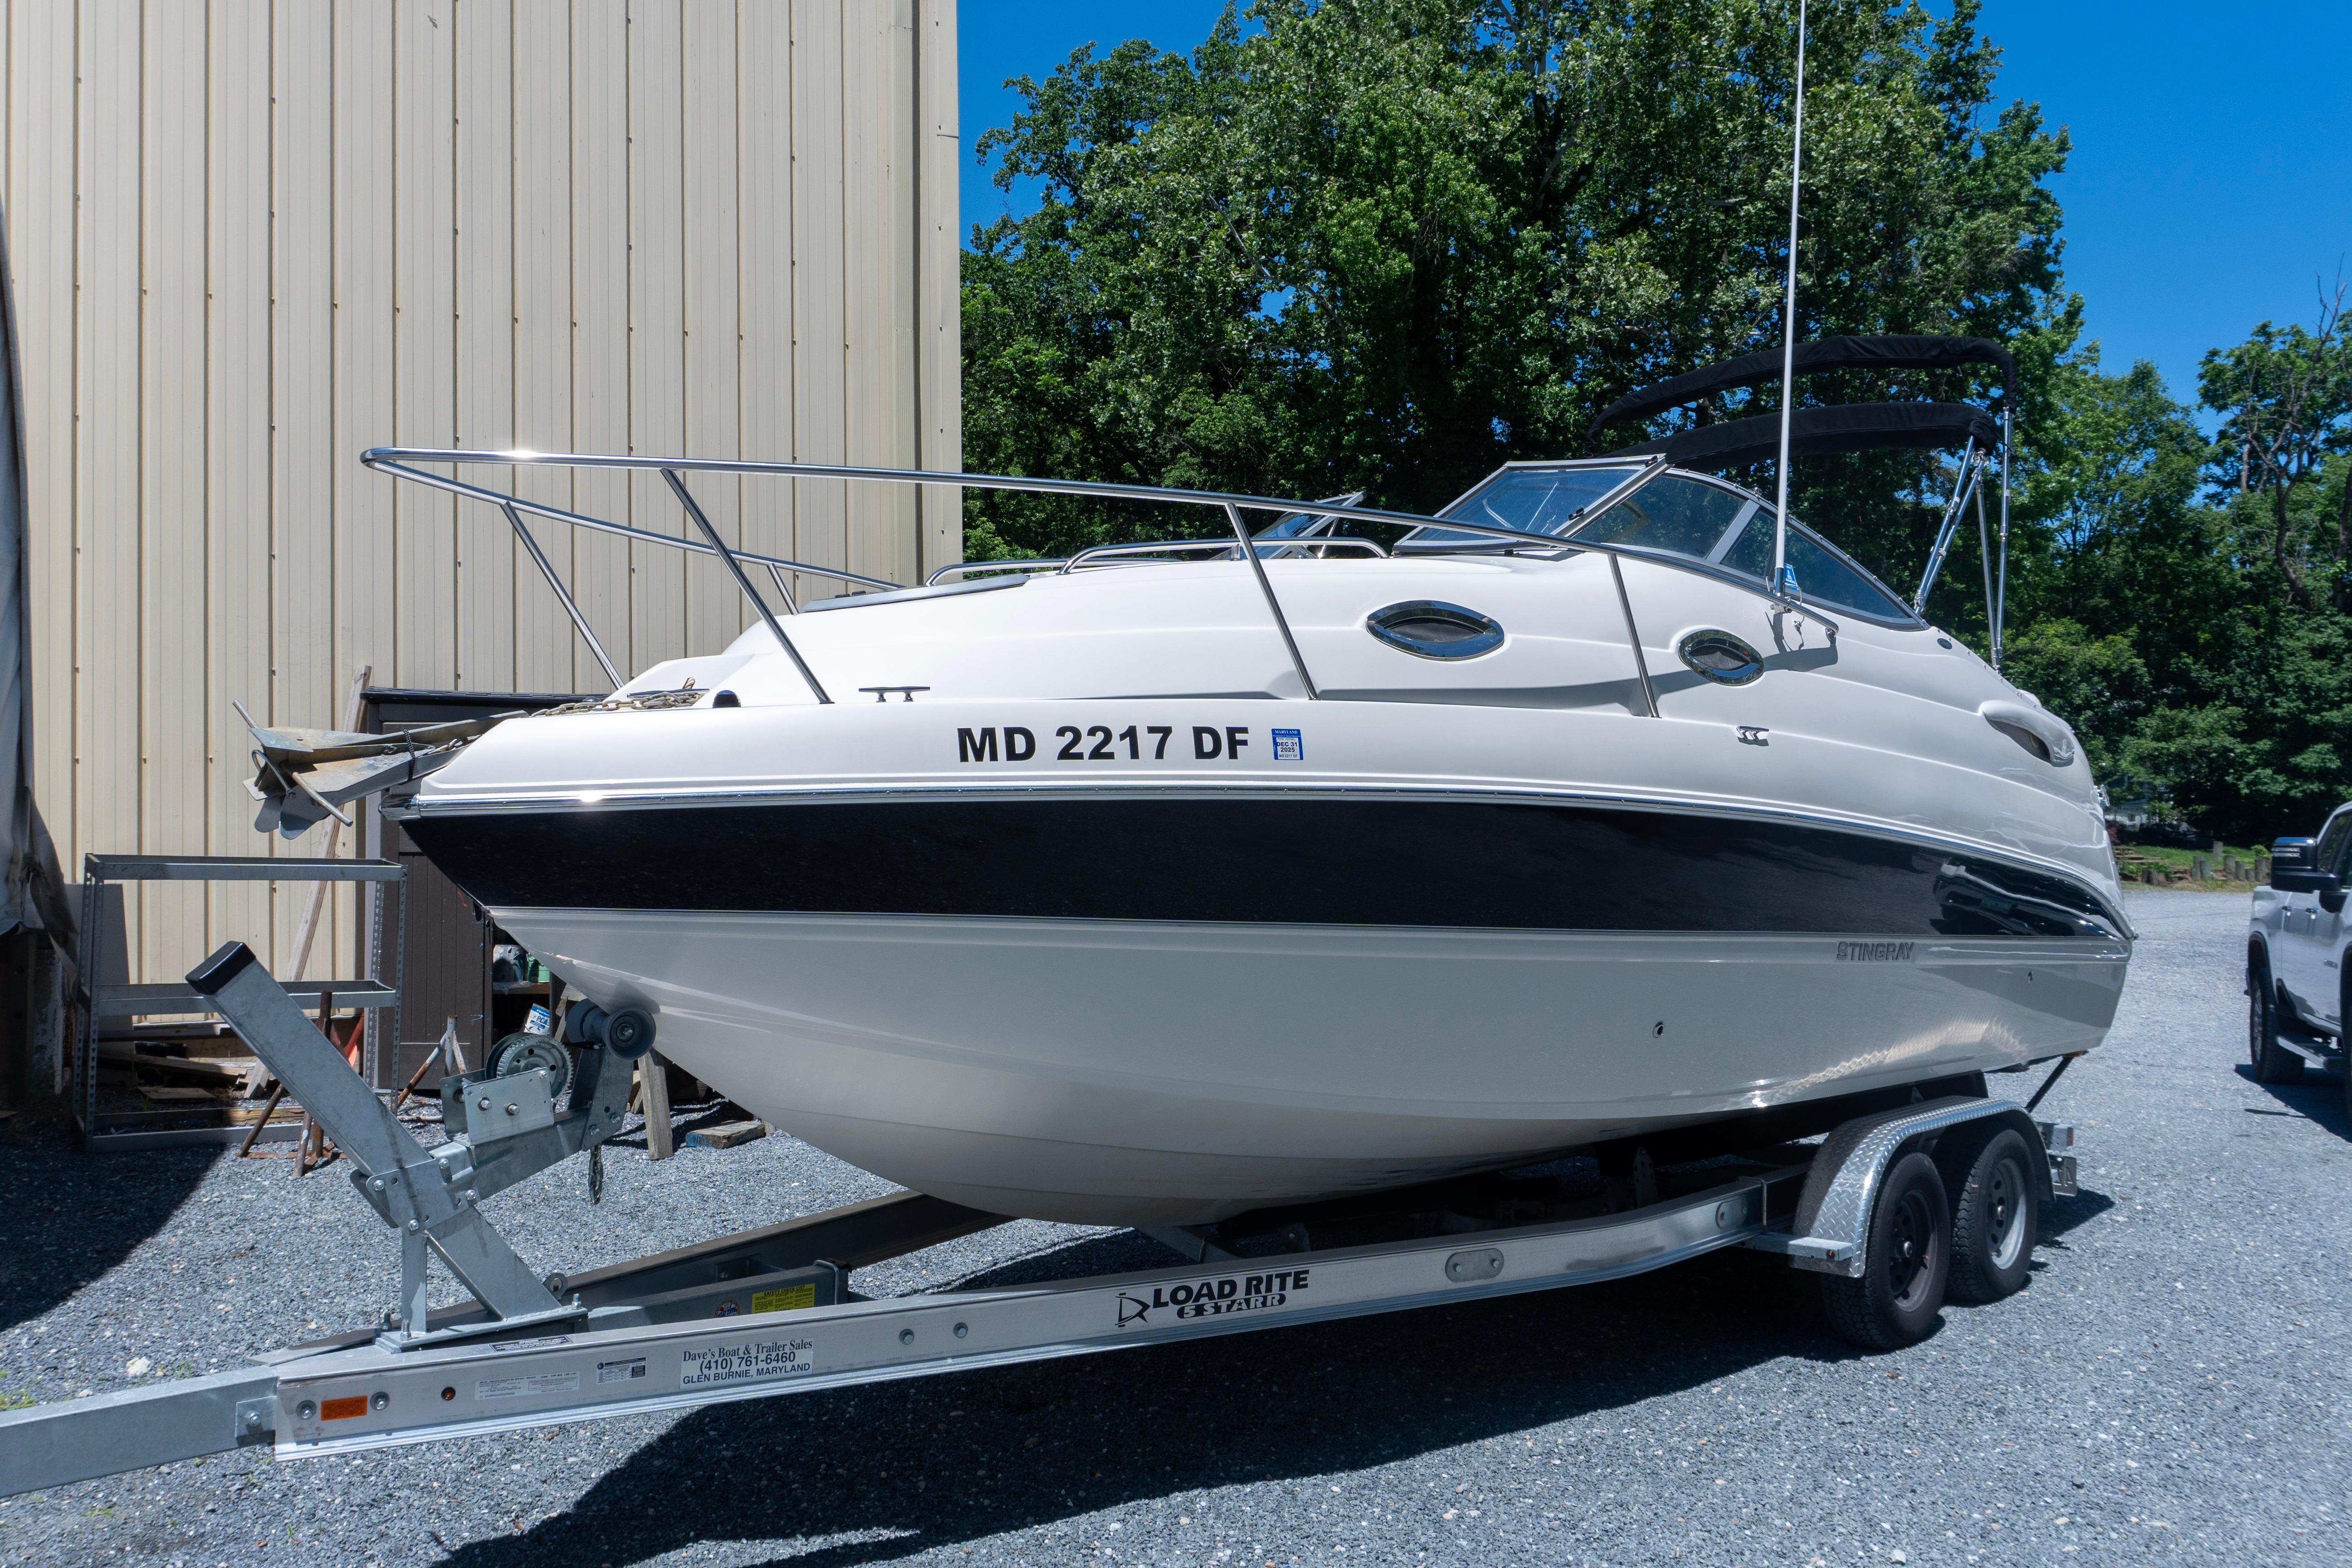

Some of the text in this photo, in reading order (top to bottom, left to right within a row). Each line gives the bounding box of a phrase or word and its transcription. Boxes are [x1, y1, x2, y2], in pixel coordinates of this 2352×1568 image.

[957, 725, 1249, 762] MD 2217 DF
[1837, 941, 1914, 961] STINGRAY
[536, 1016, 548, 1025] PCA
[1153, 1269, 1309, 1309] LOAD RITE
[1183, 1294, 1280, 1318] 5 STARR
[683, 1340, 812, 1362] Dave's Boat & Trailer Sales
[683, 1363, 811, 1385] GLEN BURNIE, MARYLAND
[700, 1351, 796, 1375] (410) 761-6460
